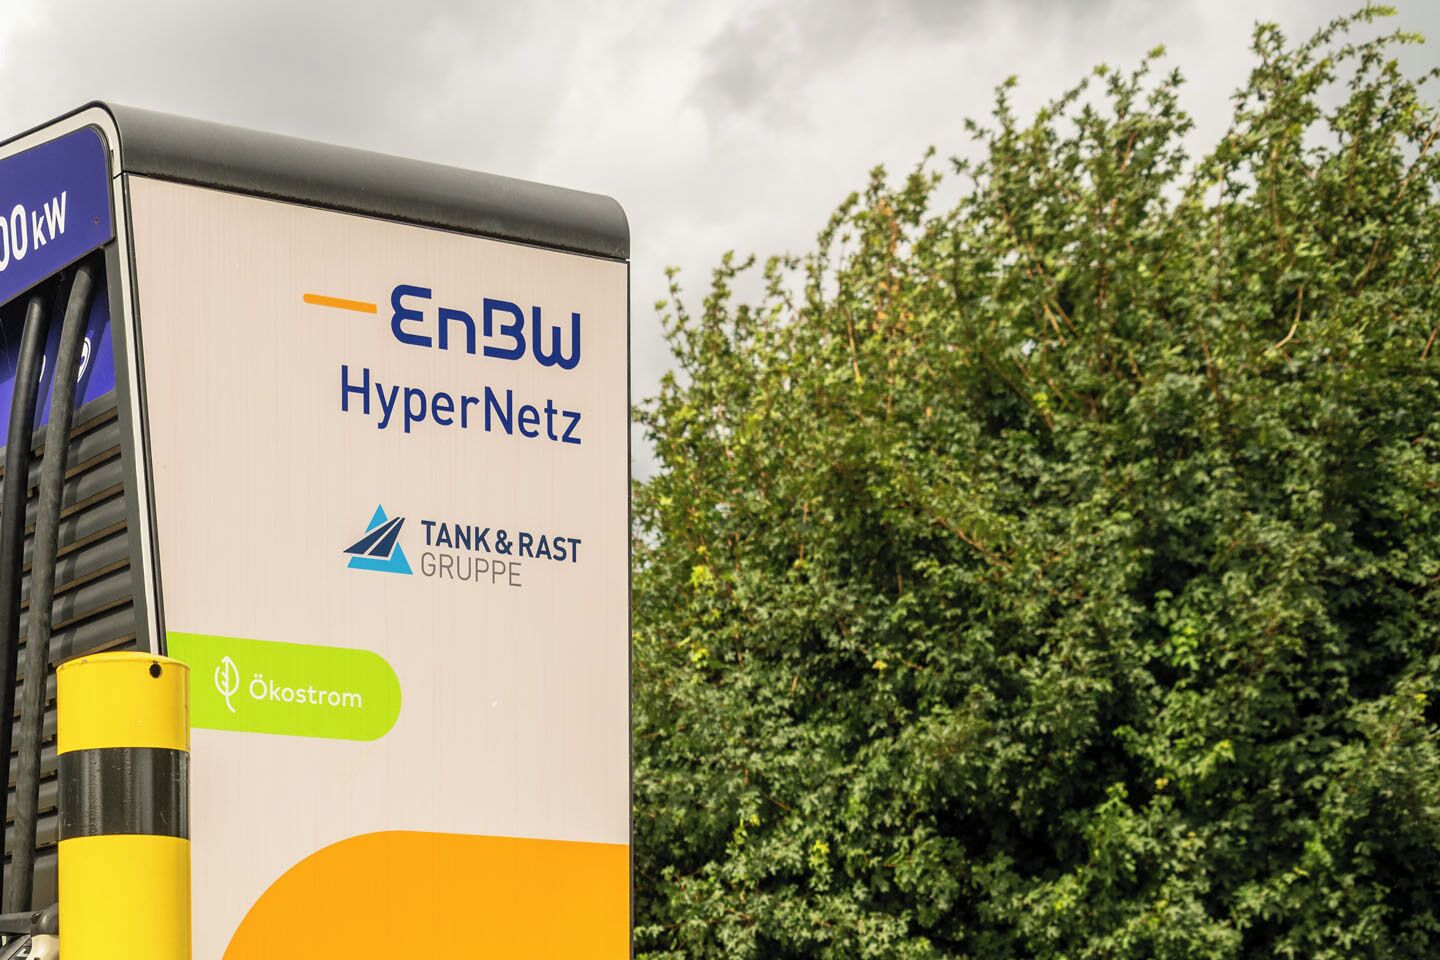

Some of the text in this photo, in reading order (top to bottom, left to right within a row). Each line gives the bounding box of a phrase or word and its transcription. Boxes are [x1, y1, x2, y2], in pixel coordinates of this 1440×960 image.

[31, 190, 67, 251] kW
[390, 284, 581, 370] EnBW
[341, 364, 582, 445] HyperNetz
[421, 552, 522, 587] GRUPPE
[249, 673, 362, 708] Ökostrom
